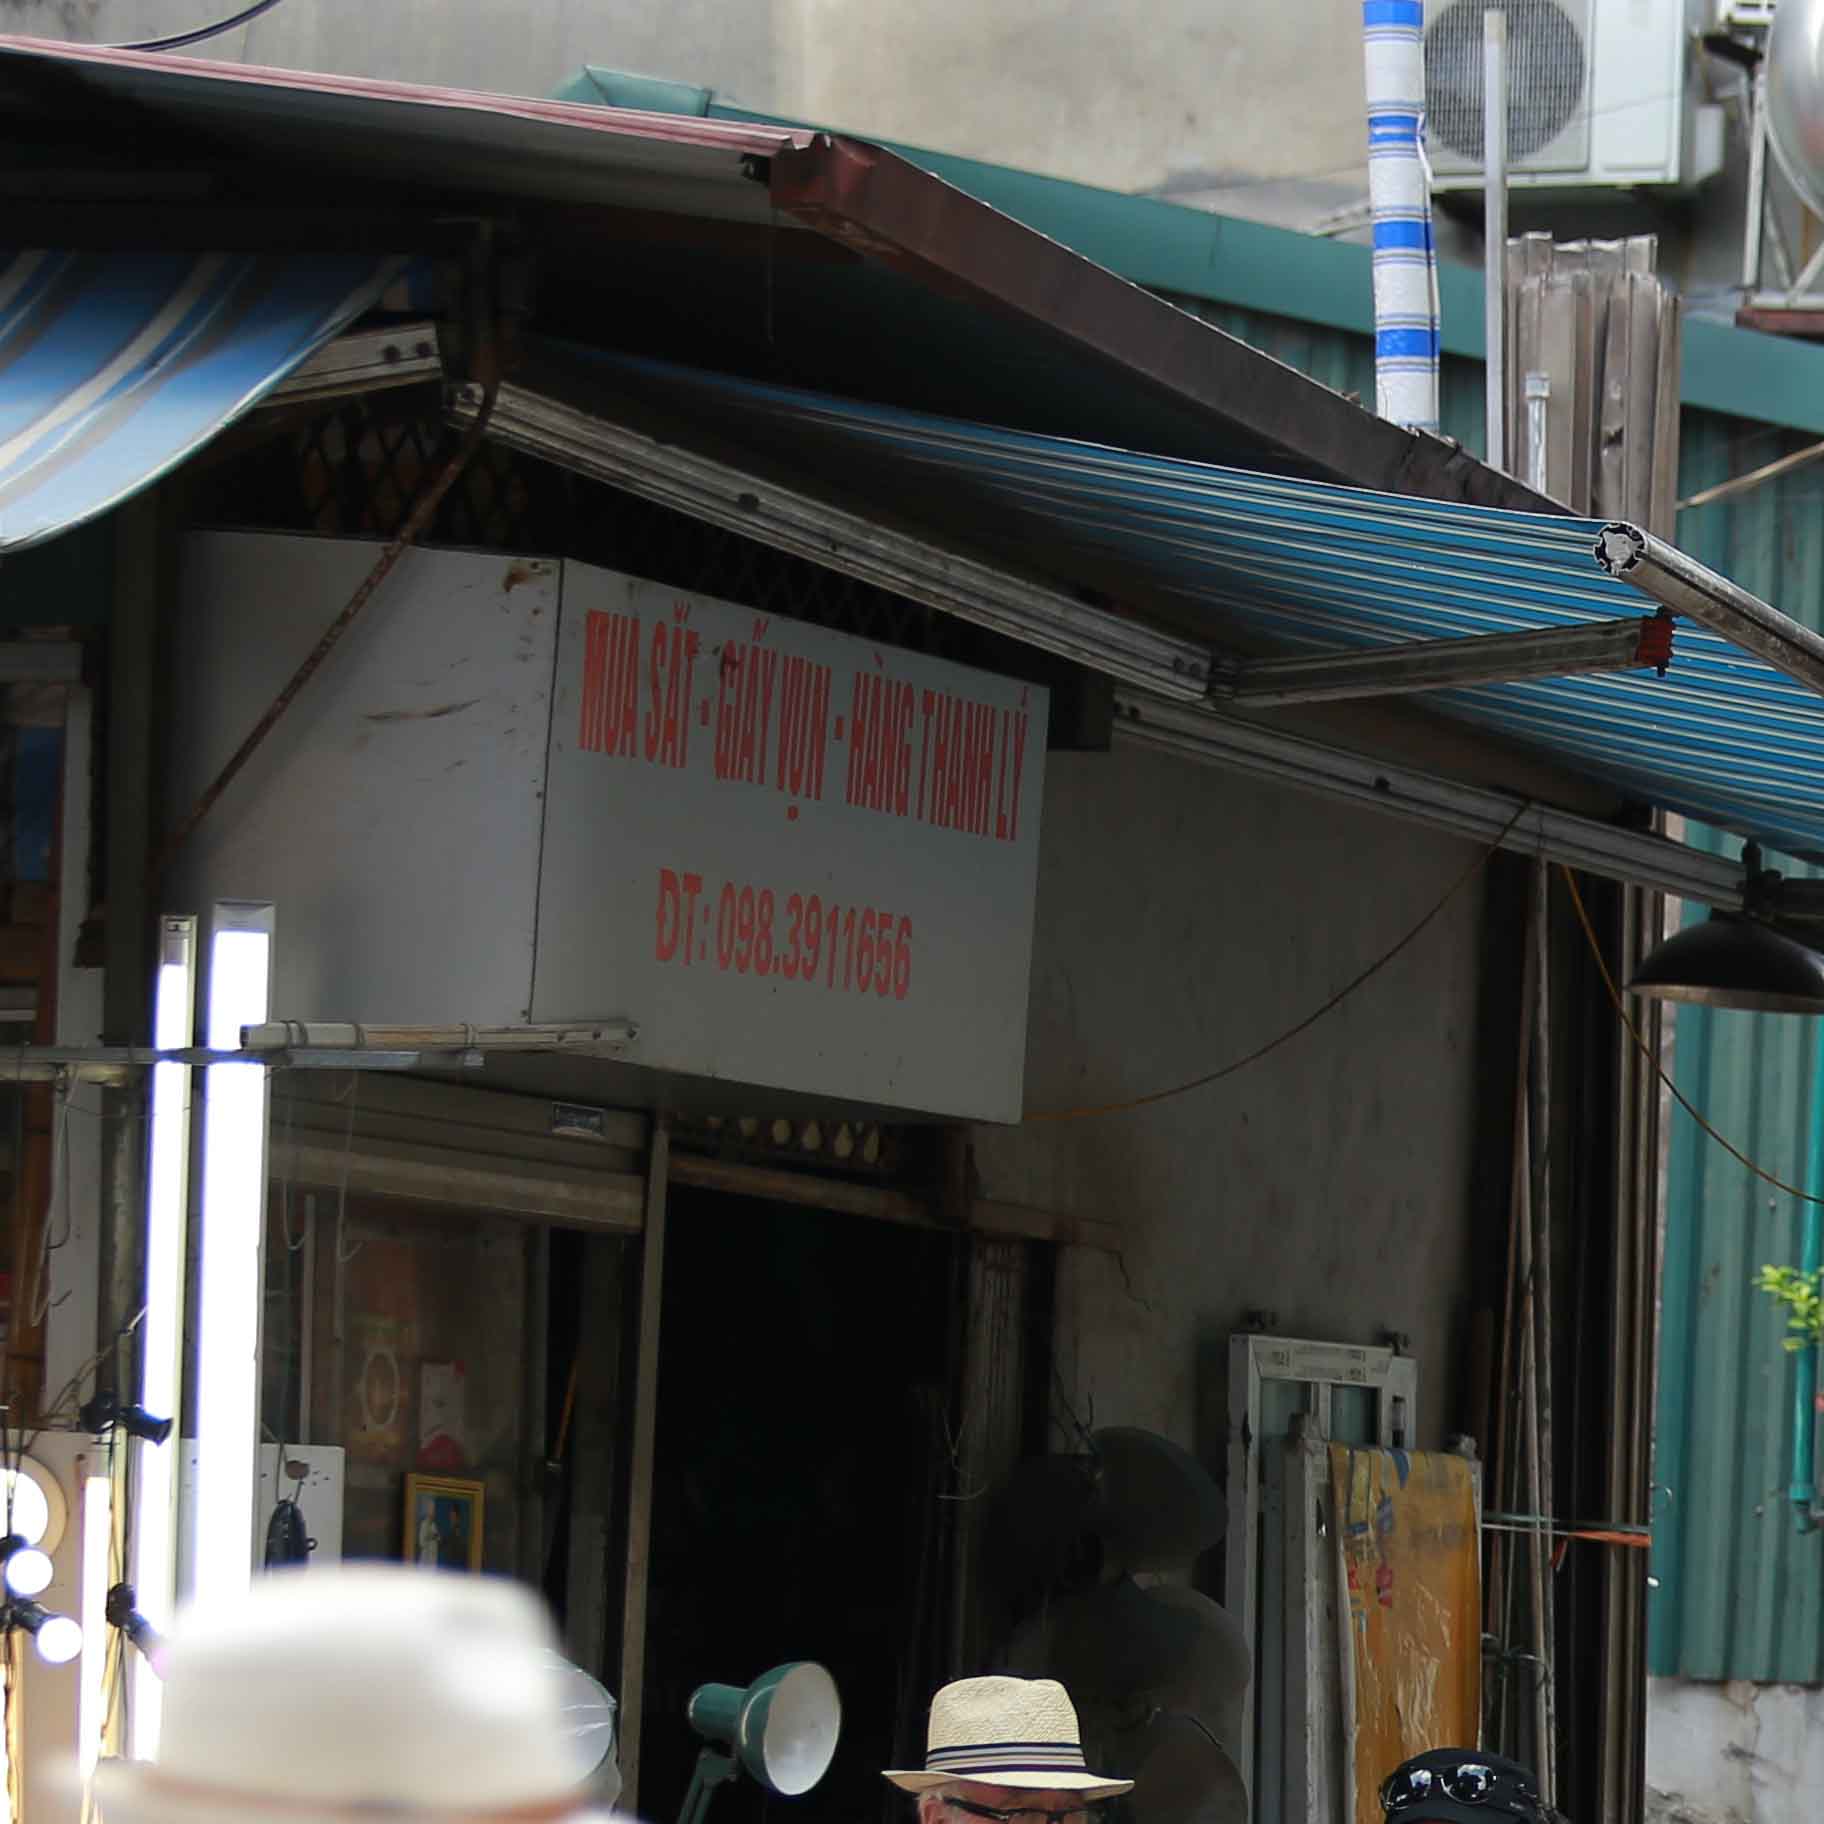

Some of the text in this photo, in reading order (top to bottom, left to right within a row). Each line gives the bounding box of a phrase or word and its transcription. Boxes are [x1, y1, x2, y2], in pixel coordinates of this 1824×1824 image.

[578, 608, 641, 758] MUA
[644, 599, 700, 769] SẮT
[776, 655, 832, 822] VỤN
[846, 650, 914, 817] HÀNG
[916, 687, 997, 836] THANH
[996, 686, 1029, 841] LÝ
